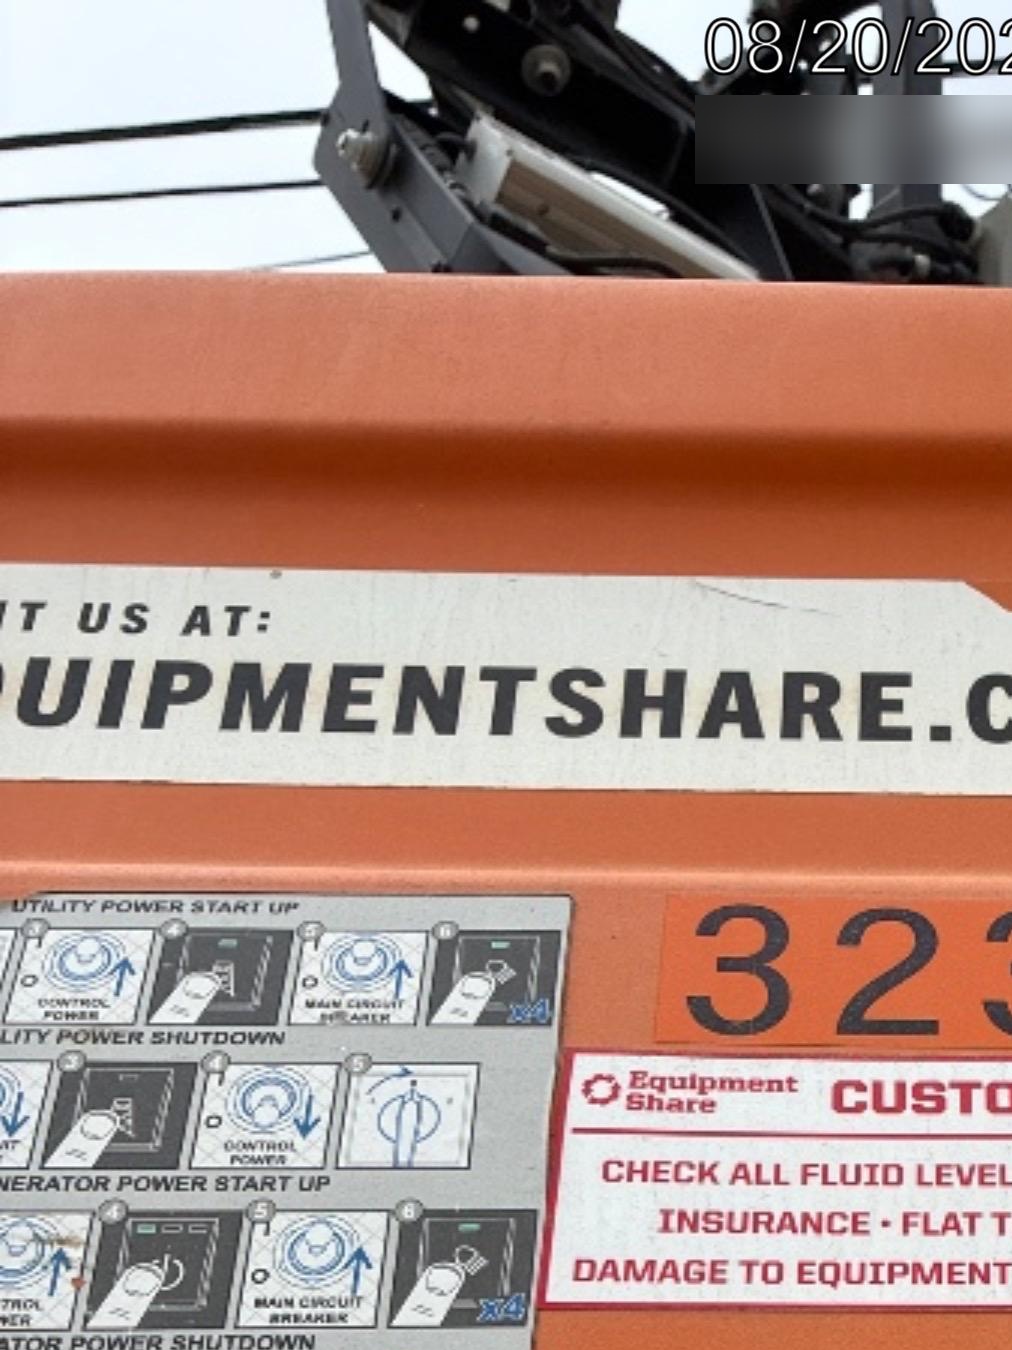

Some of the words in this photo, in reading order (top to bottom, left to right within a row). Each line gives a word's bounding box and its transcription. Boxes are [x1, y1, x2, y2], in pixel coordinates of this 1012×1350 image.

[78, 602, 150, 634] US
[181, 604, 271, 637] AT:
[12, 900, 94, 914] UTILITY
[100, 900, 184, 914] POWER
[191, 900, 260, 914] START
[269, 902, 299, 915] UP
[0, 1030, 48, 1044] LITY
[56, 1030, 144, 1045] POWER
[150, 1030, 286, 1045] SHUTDOWN
[64, 1055, 78, 1070] 3
[209, 1056, 221, 1070] 4
[629, 1071, 798, 1095] Equipment
[625, 1092, 717, 1113] Share
[601, 1160, 719, 1184] CHECK
[729, 1161, 790, 1186] ALL
[801, 1162, 902, 1186] FLUID
[116, 1176, 207, 1193] POWER
[214, 1176, 292, 1192] START
[299, 1176, 330, 1192] UP
[106, 1204, 118, 1220] 4
[254, 1204, 267, 1218] 5
[659, 1208, 870, 1236] INSURANCE
[903, 1211, 982, 1236] FLAT
[573, 1258, 728, 1285] DAMAGE
[740, 1260, 784, 1285] TO
[254, 1297, 294, 1308] MAIN
